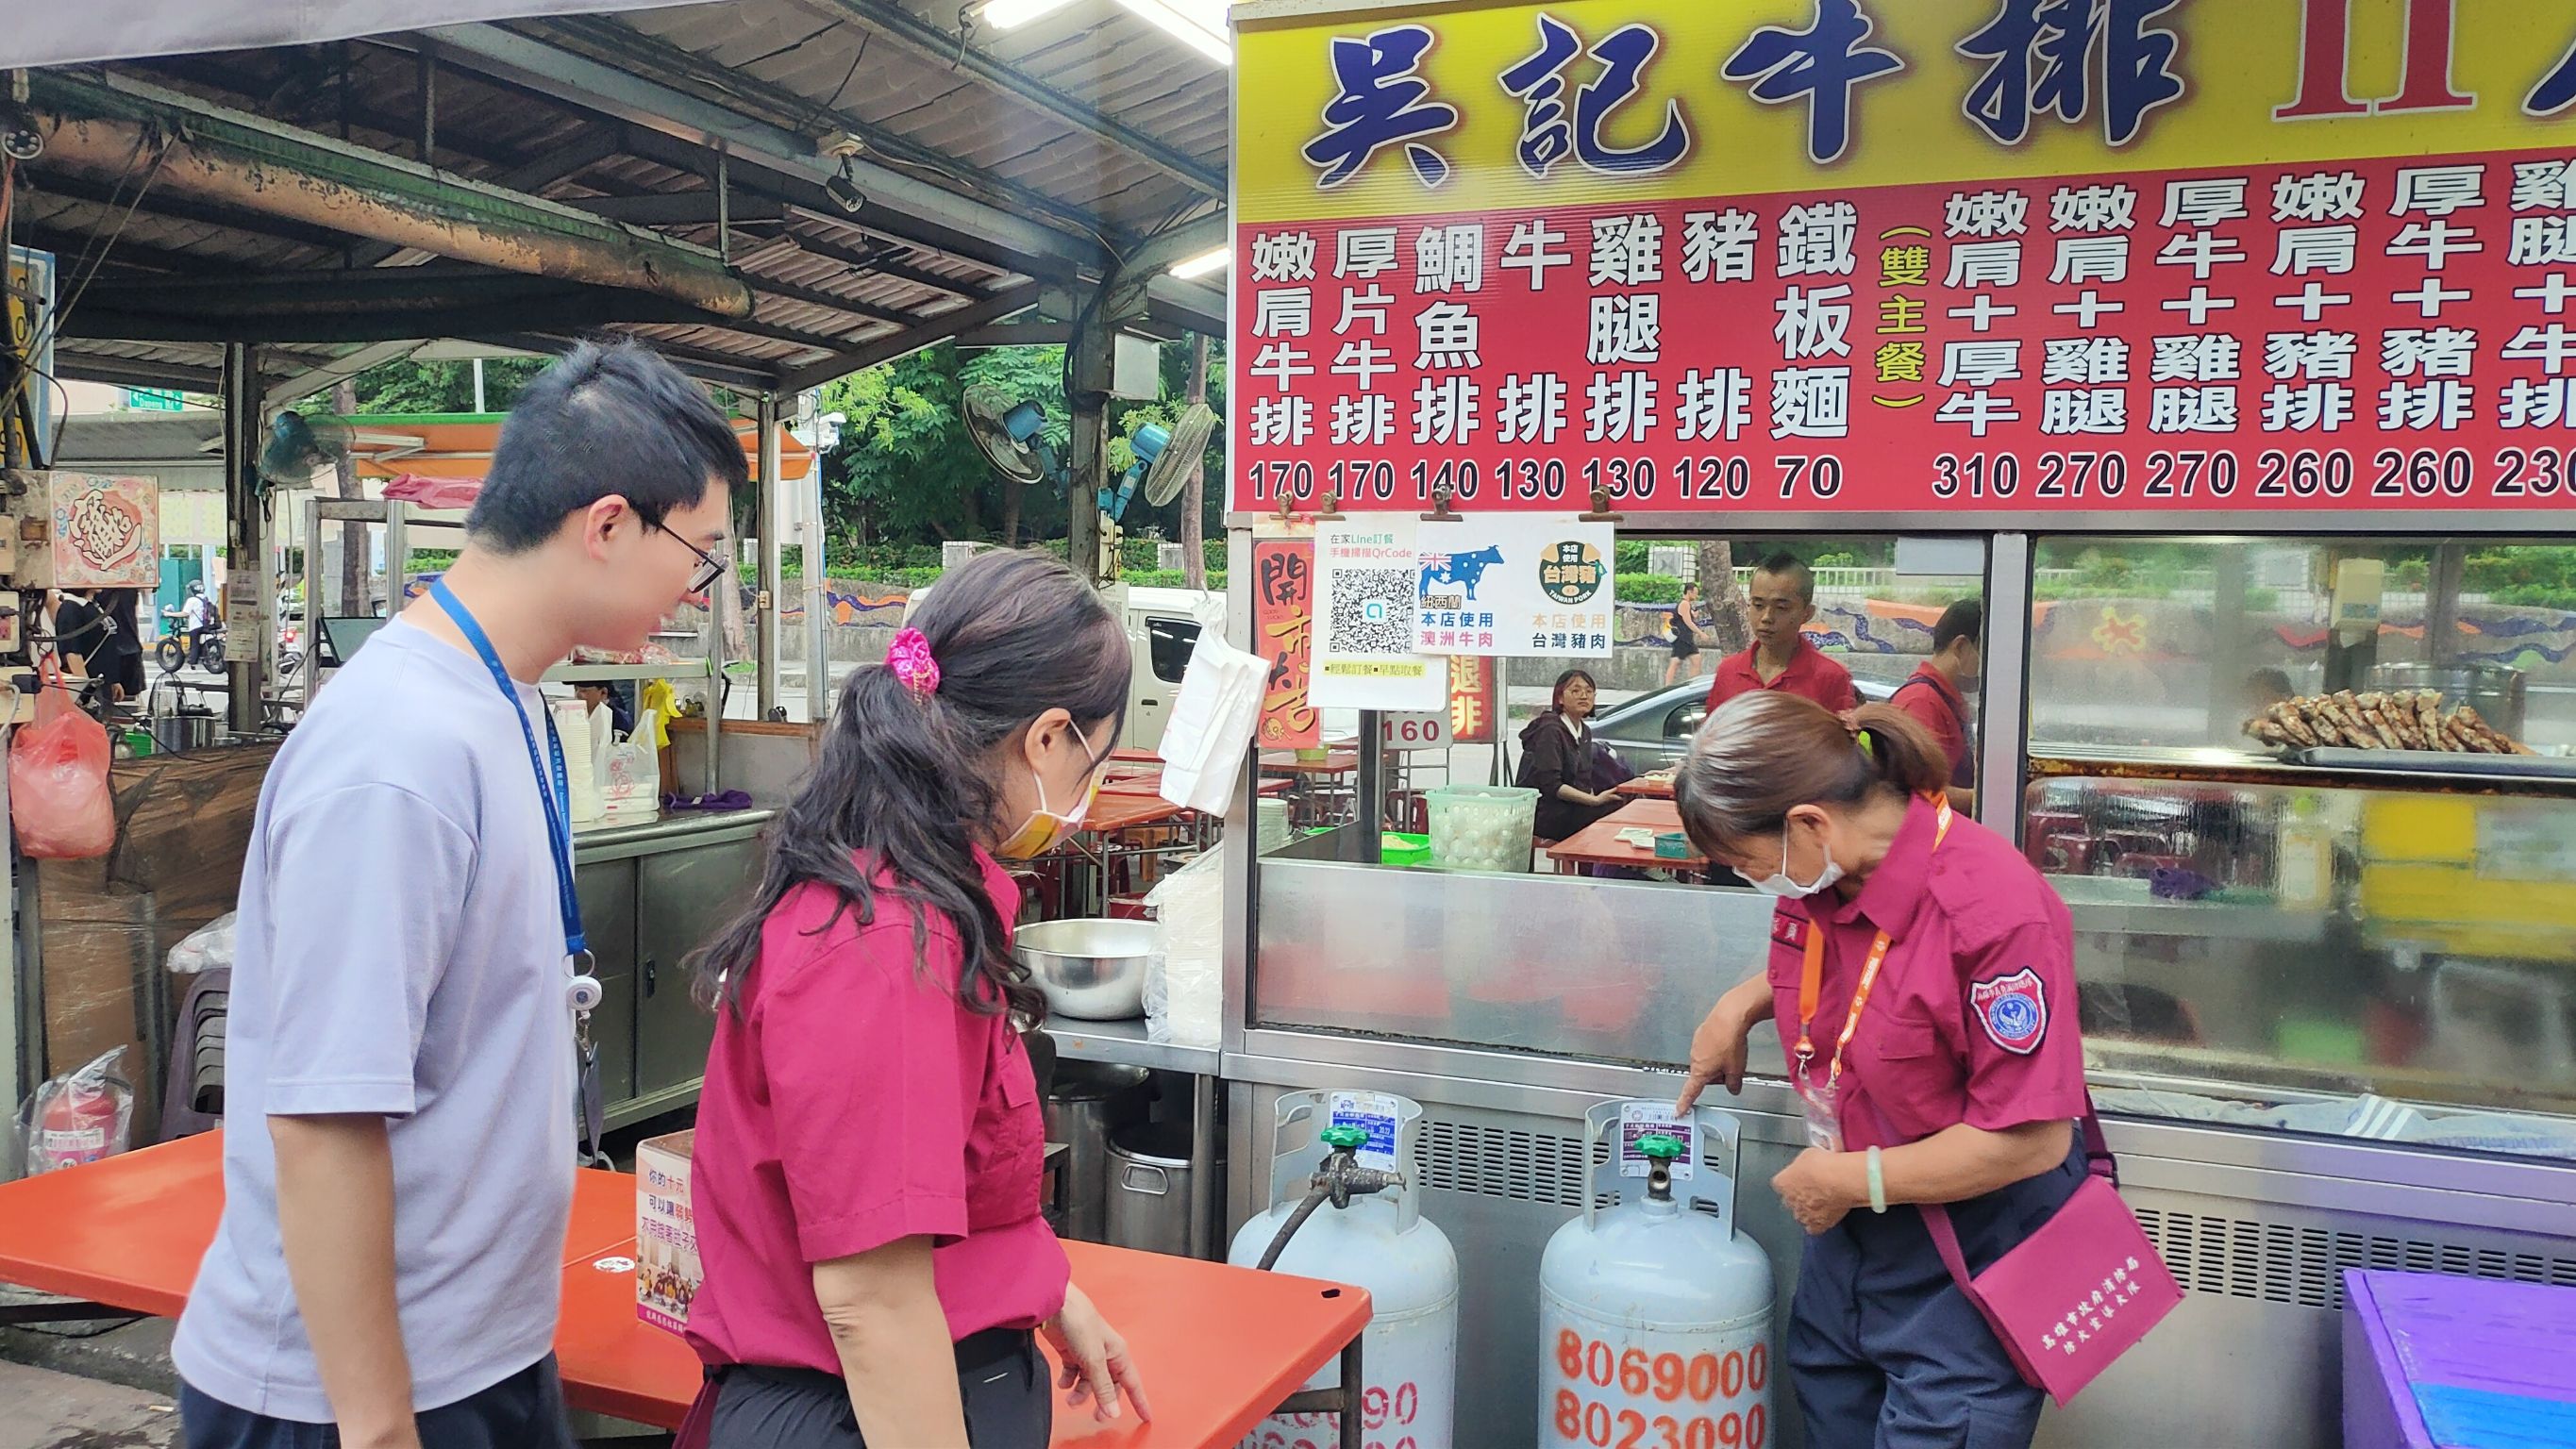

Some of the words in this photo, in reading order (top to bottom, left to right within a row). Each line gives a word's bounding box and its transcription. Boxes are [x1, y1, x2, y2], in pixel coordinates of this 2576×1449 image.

[1302, 0, 2185, 189] 吳記牛排
[1250, 232, 1316, 445] 嫩肩牛排
[1330, 228, 1399, 445] 厚片牛排
[1412, 225, 1482, 445] 鯛魚排
[1497, 220, 1571, 444] 牛排
[1584, 215, 1662, 444] 雞腿排
[1675, 208, 1758, 441] 豬排
[1769, 202, 1858, 441] 鐵板麵
[1249, 460, 1313, 499] 170
[1328, 459, 1394, 500] 170
[1411, 458, 1480, 500] 140
[1496, 458, 1566, 500] 130
[1582, 458, 1656, 500] 130
[1674, 457, 1749, 500] 120
[1777, 457, 1842, 499] 70
[1932, 453, 2020, 499] 310
[2037, 451, 2128, 498] 270
[2145, 450, 2238, 497] 270
[2257, 448, 2353, 497] 260
[2372, 447, 2473, 497] 260
[1420, 594, 1462, 609] 紐西蘭
[1421, 612, 1494, 627] 本店使用
[1548, 589, 1573, 604] TAIWAN
[1574, 590, 1593, 604] PORK
[1420, 631, 1494, 647] 澳洲牛肉
[1532, 613, 1606, 628] 本店使用
[1532, 633, 1605, 649] 台灣豬肉
[1382, 720, 1440, 741] 160
[1558, 1328, 1767, 1403] 8069000
[1555, 1388, 1765, 1449] 8023090
